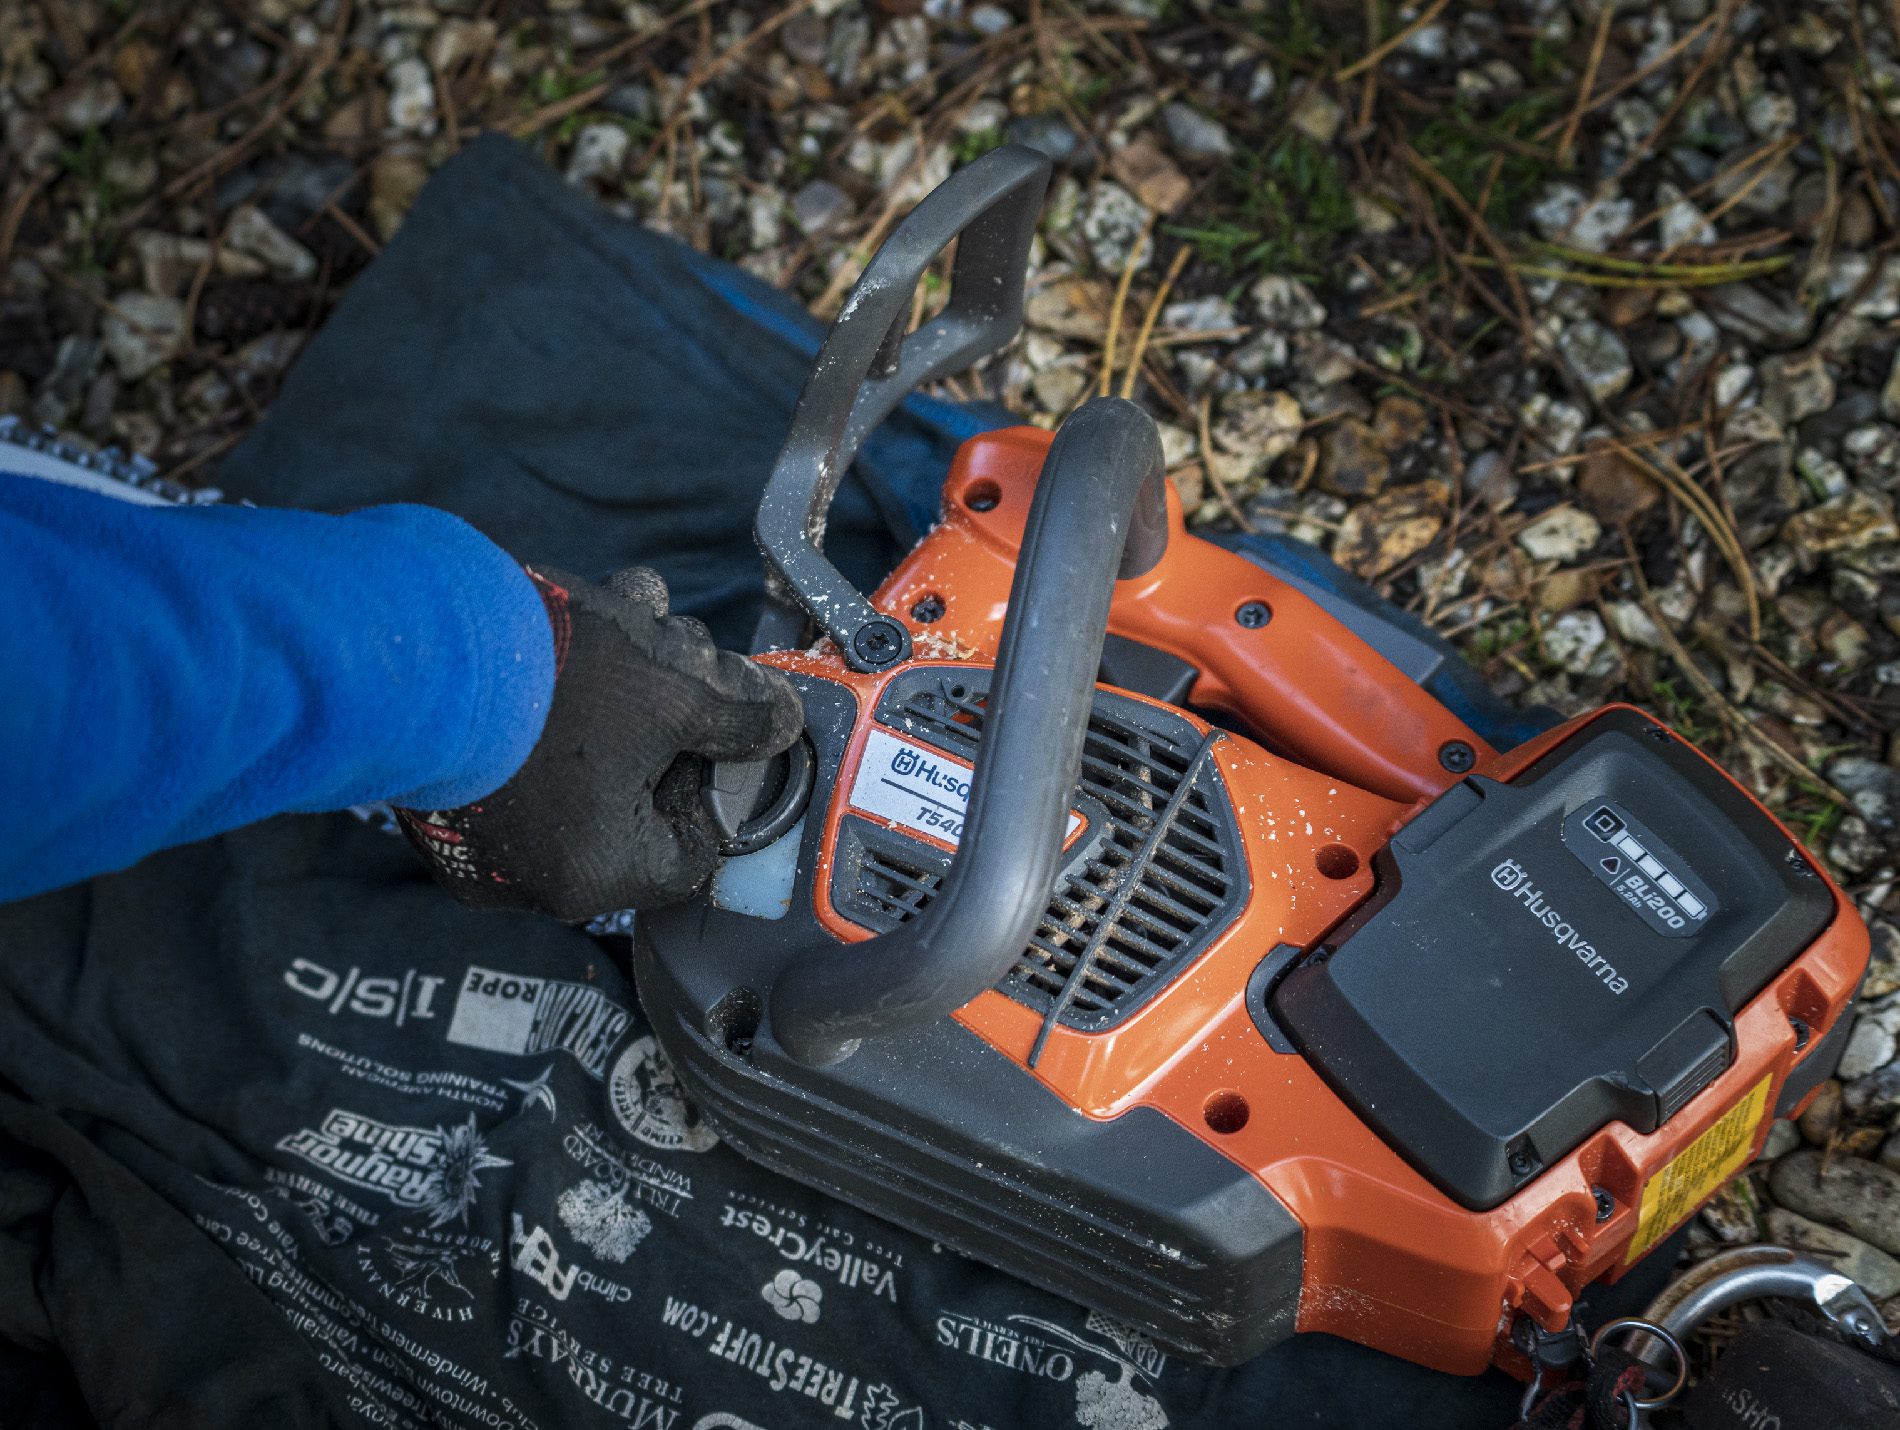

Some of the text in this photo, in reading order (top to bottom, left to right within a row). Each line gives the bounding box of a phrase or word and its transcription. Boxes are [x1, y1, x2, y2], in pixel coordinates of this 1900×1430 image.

[1624, 875, 1685, 929] BLi200
[1514, 881, 1629, 995] Husqvarna
[466, 972, 538, 1004] ROPE
[297, 1033, 508, 1099] TRAINING SOLUTIONS
[341, 1064, 504, 1109] NORTH AMERICAN
[290, 1138, 441, 1200] Raynor
[328, 1118, 442, 1166] Shine
[719, 1205, 897, 1303] ValleyCrest
[727, 1191, 902, 1268] Tree Care Services
[357, 1244, 474, 1322] HIVERNANT
[381, 1322, 488, 1397] Windermere
[936, 1316, 1074, 1381] O'NEIL'S
[620, 1366, 682, 1404] TREE
